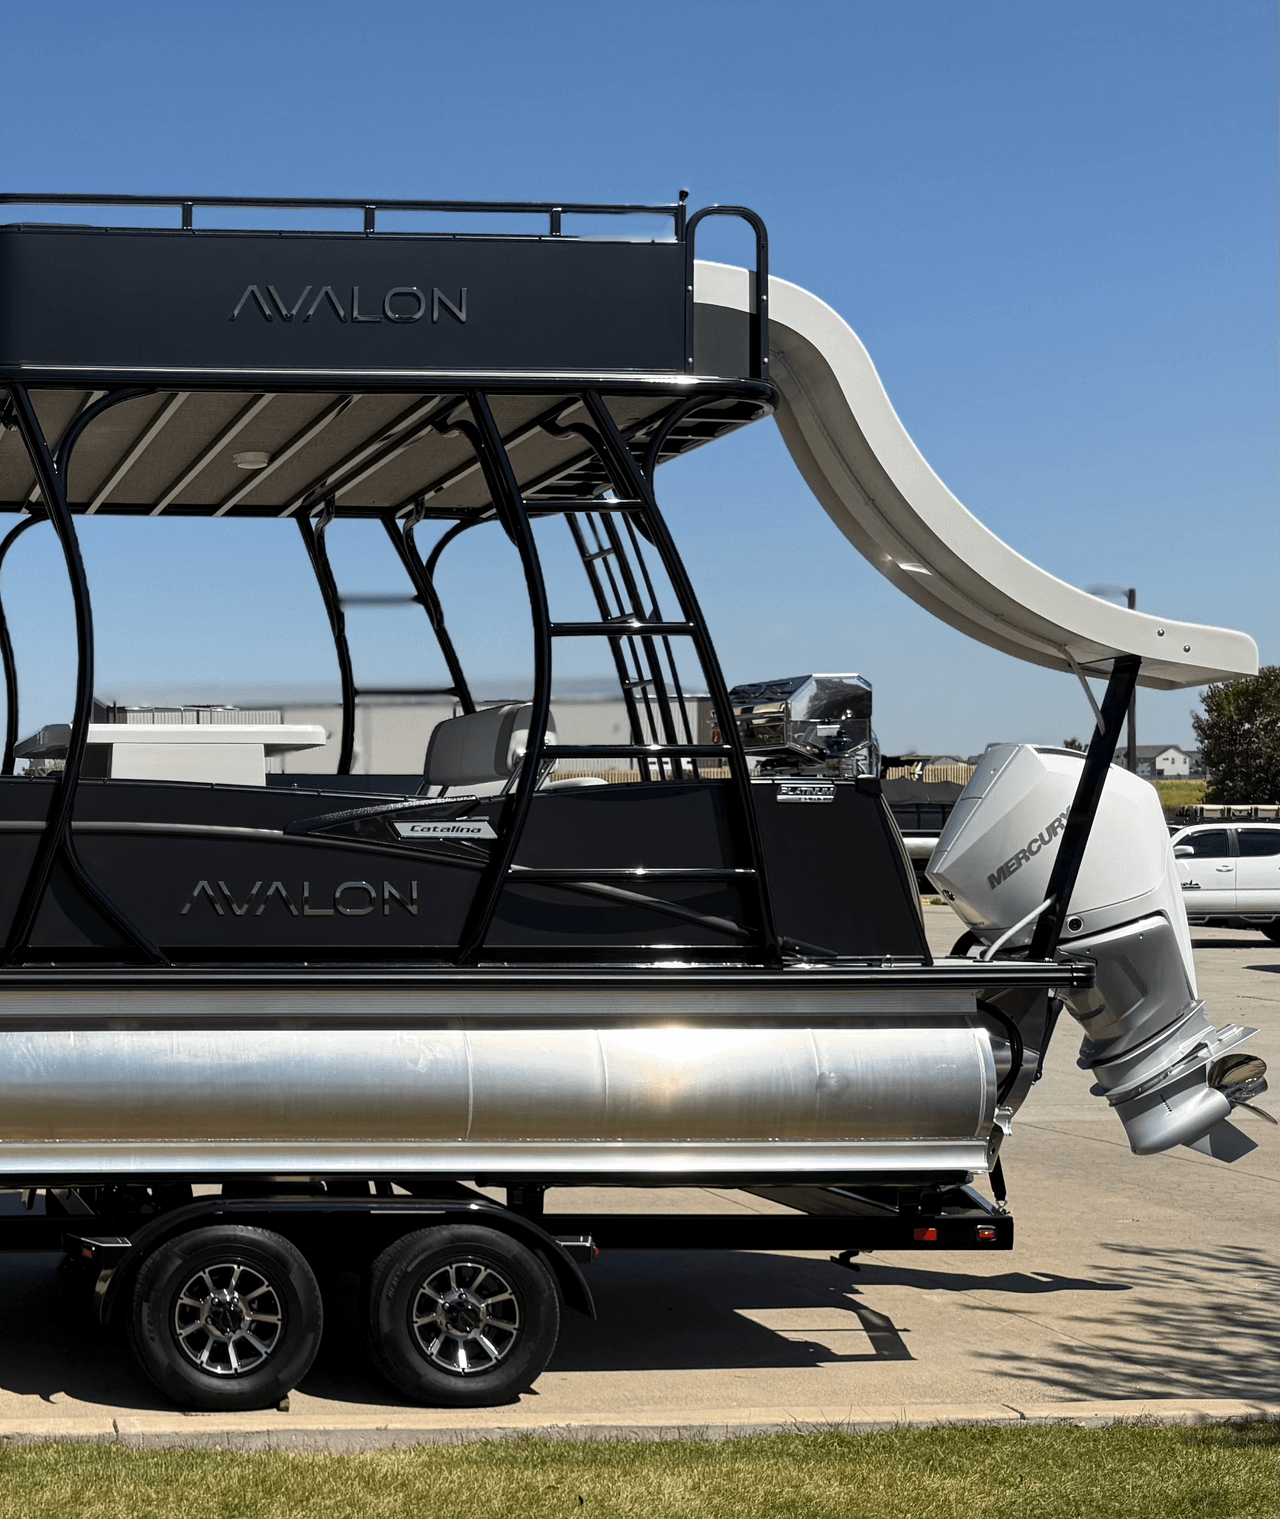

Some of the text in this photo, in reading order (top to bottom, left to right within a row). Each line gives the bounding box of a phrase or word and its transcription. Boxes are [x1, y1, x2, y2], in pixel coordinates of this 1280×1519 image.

[229, 284, 468, 323] AVALON
[780, 787, 835, 795] PLATINUM
[410, 824, 482, 834] Catalina
[180, 880, 418, 916] AVALON
